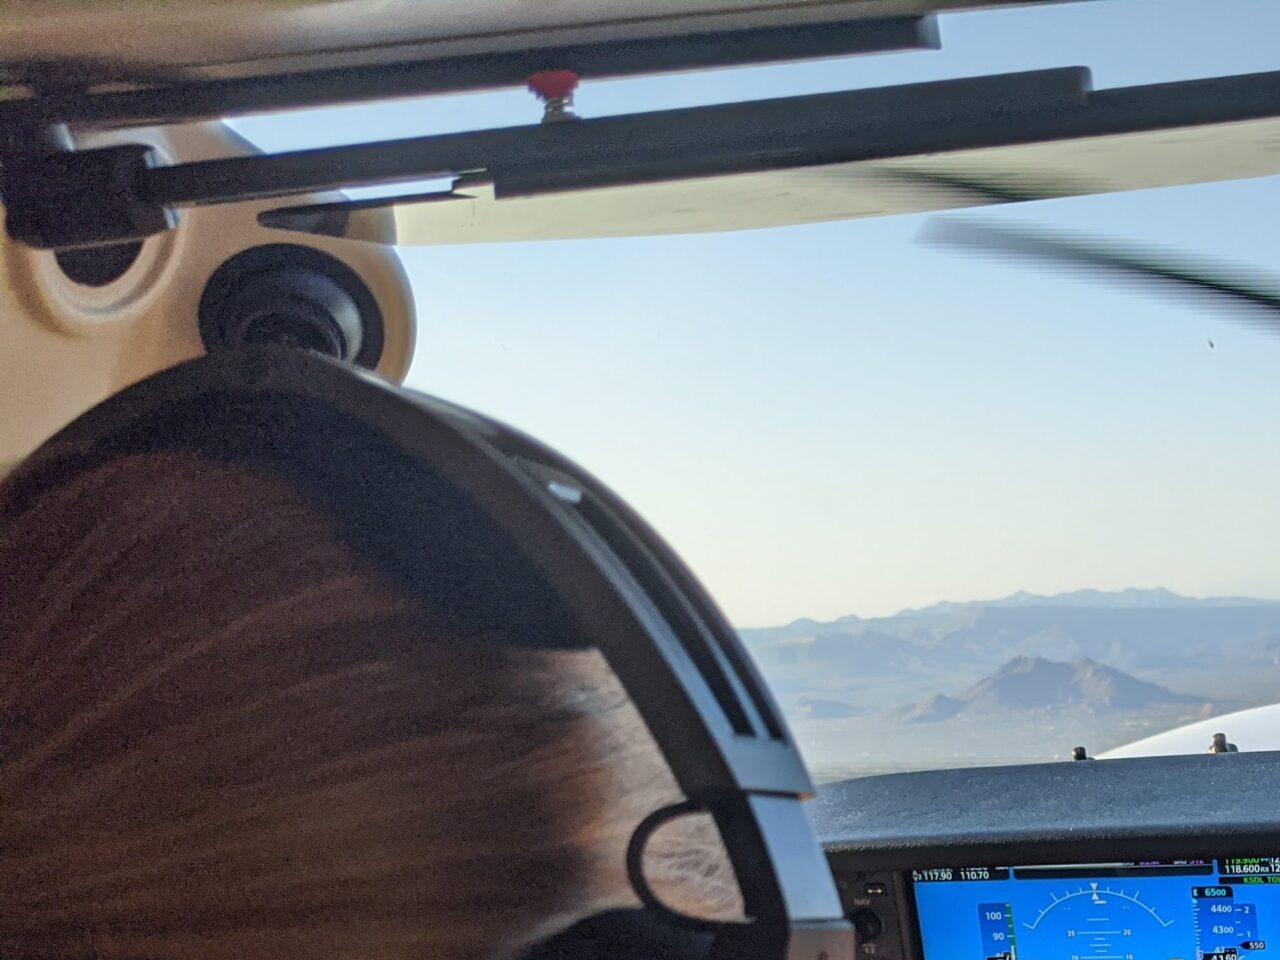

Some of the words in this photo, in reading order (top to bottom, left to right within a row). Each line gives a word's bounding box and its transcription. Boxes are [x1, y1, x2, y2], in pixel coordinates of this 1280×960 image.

[1225, 865, 1260, 874] 118.600
[923, 872, 952, 880] 117.90
[961, 871, 989, 880] 110.70
[1204, 888, 1226, 896] 6500
[986, 912, 1002, 920] 100
[1212, 926, 1234, 934] 4300
[992, 932, 1004, 940] 90
